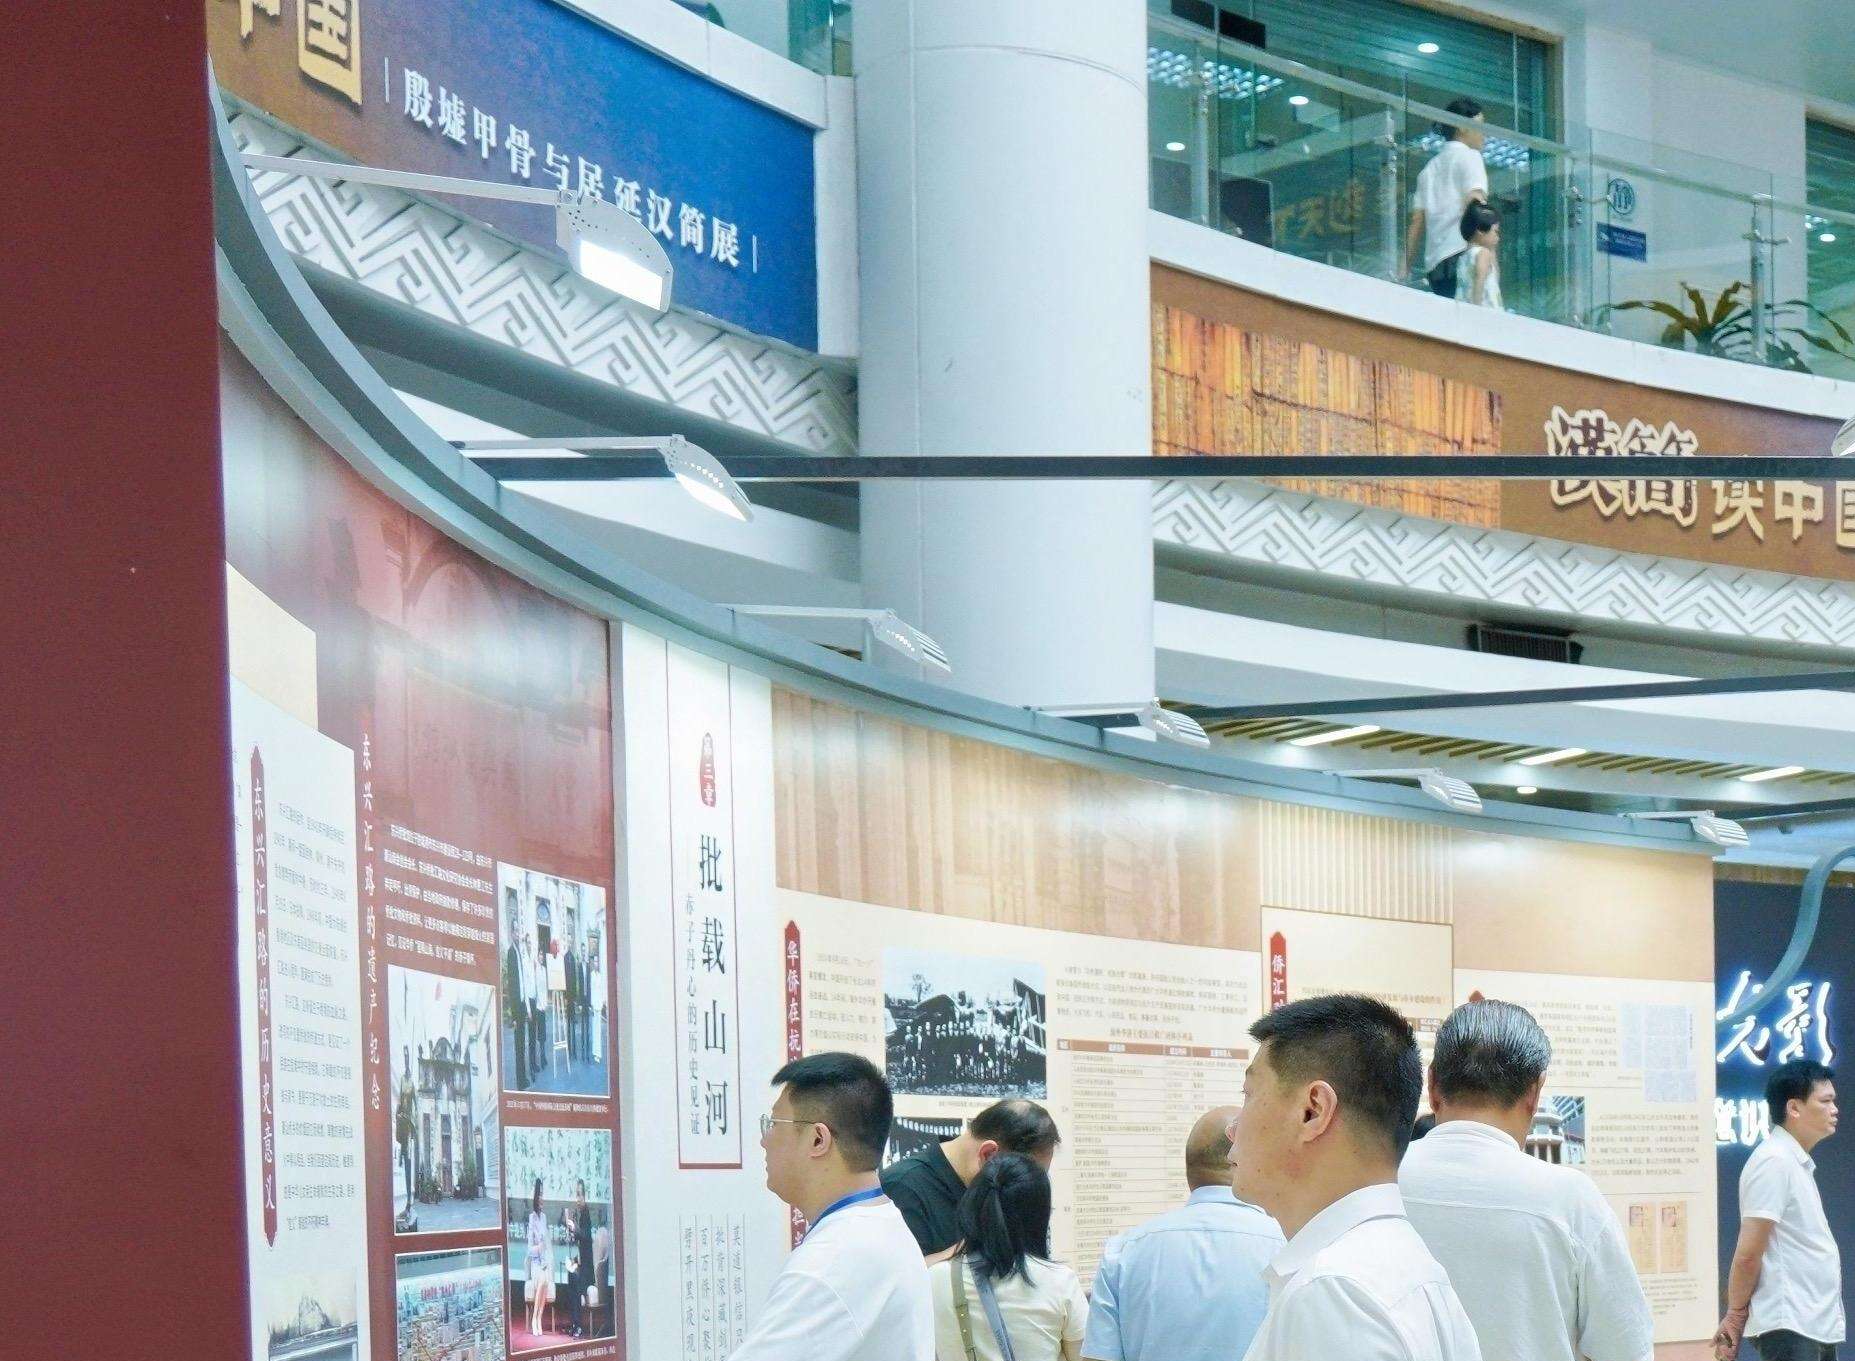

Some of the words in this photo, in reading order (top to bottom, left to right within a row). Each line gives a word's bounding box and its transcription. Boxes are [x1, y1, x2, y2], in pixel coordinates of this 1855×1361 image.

[253, 779, 276, 1211] 东兴汇路的历史意义
[684, 893, 700, 1137] 赤子丹心的历史见证
[700, 833, 730, 1137] 批载山河
